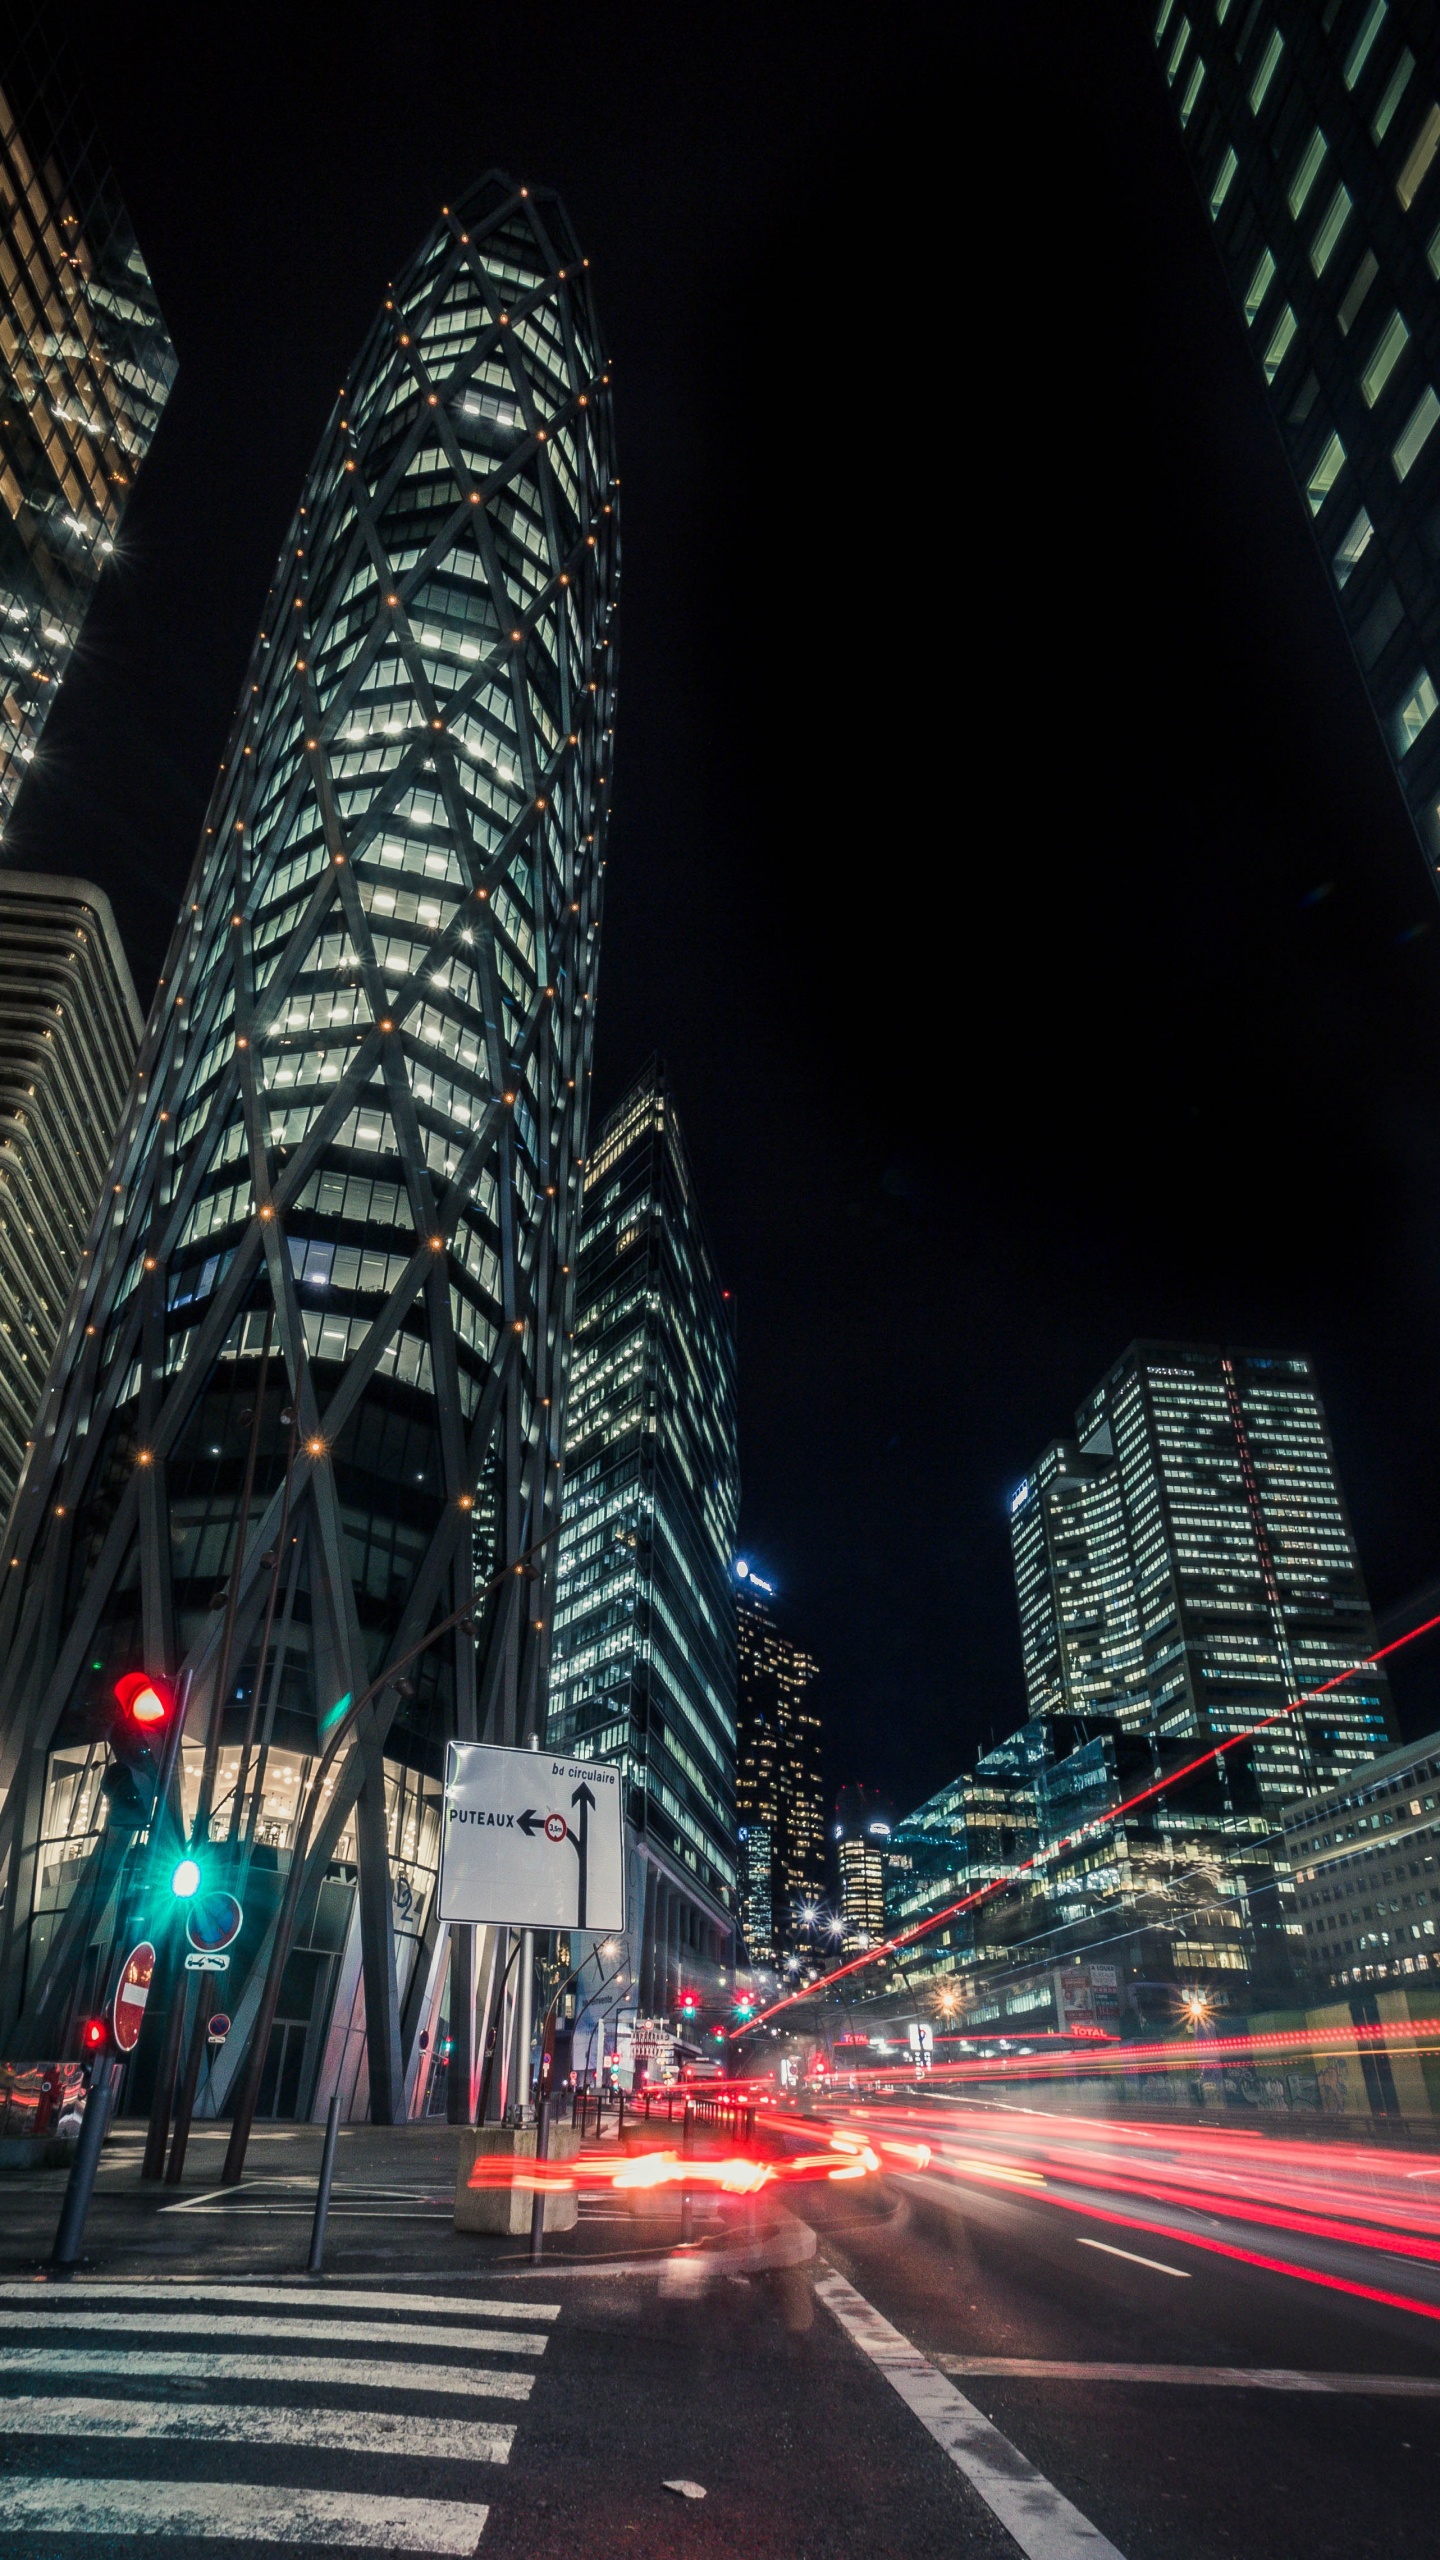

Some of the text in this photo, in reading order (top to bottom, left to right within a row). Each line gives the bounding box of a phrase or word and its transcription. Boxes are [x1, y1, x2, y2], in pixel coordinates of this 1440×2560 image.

[552, 1763, 615, 1784] bd circulaire
[449, 1809, 514, 1828] PUTEAUX
[843, 2034, 869, 2043] TOTAL
[1071, 2024, 1108, 2037] TOTAL
